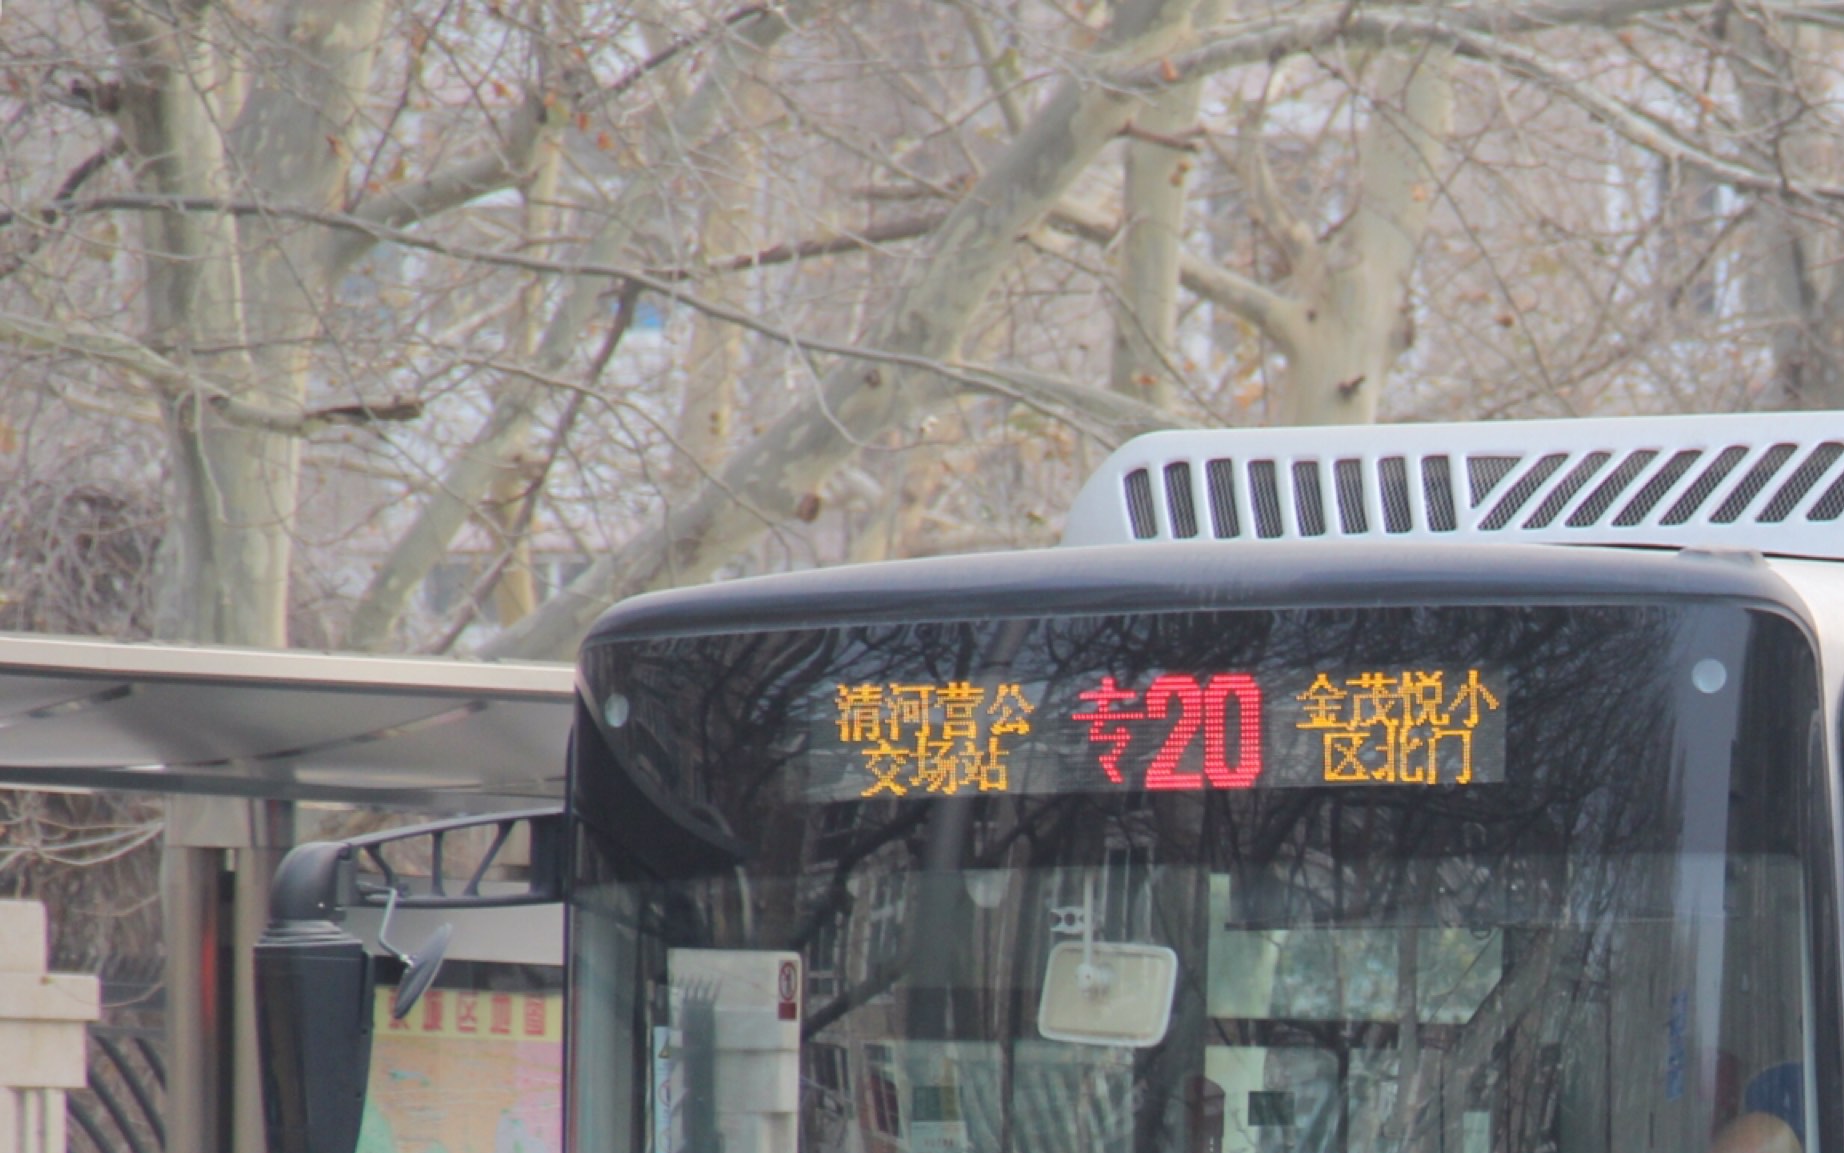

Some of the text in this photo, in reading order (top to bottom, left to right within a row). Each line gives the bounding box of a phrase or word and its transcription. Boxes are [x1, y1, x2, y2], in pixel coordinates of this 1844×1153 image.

[834, 681, 1035, 742] 清河营公
[1295, 668, 1500, 731] 金茂悦小
[1072, 674, 1263, 790] 专20
[1324, 726, 1472, 785] 区北门
[861, 737, 1010, 798] 交场站
